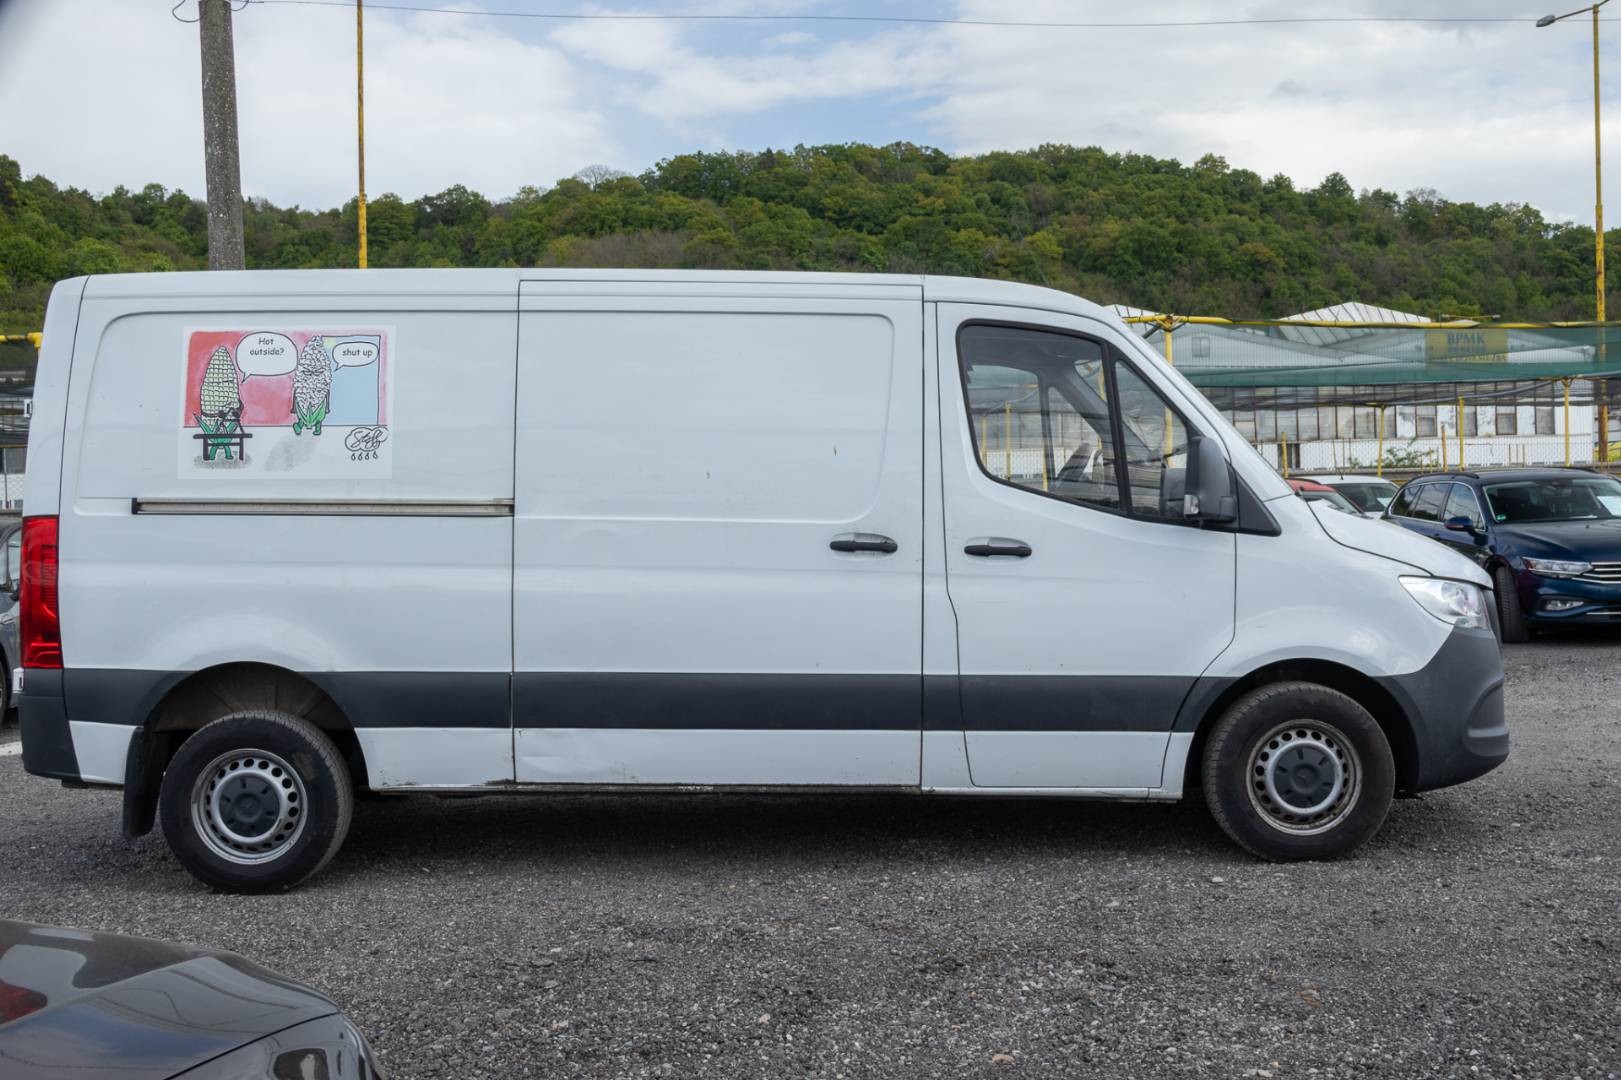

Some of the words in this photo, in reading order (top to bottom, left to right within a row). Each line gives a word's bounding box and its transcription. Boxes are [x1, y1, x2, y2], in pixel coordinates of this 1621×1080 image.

[258, 337, 274, 345] Hot
[249, 348, 285, 356] outside?
[342, 348, 361, 357] shut
[363, 349, 373, 358] up
